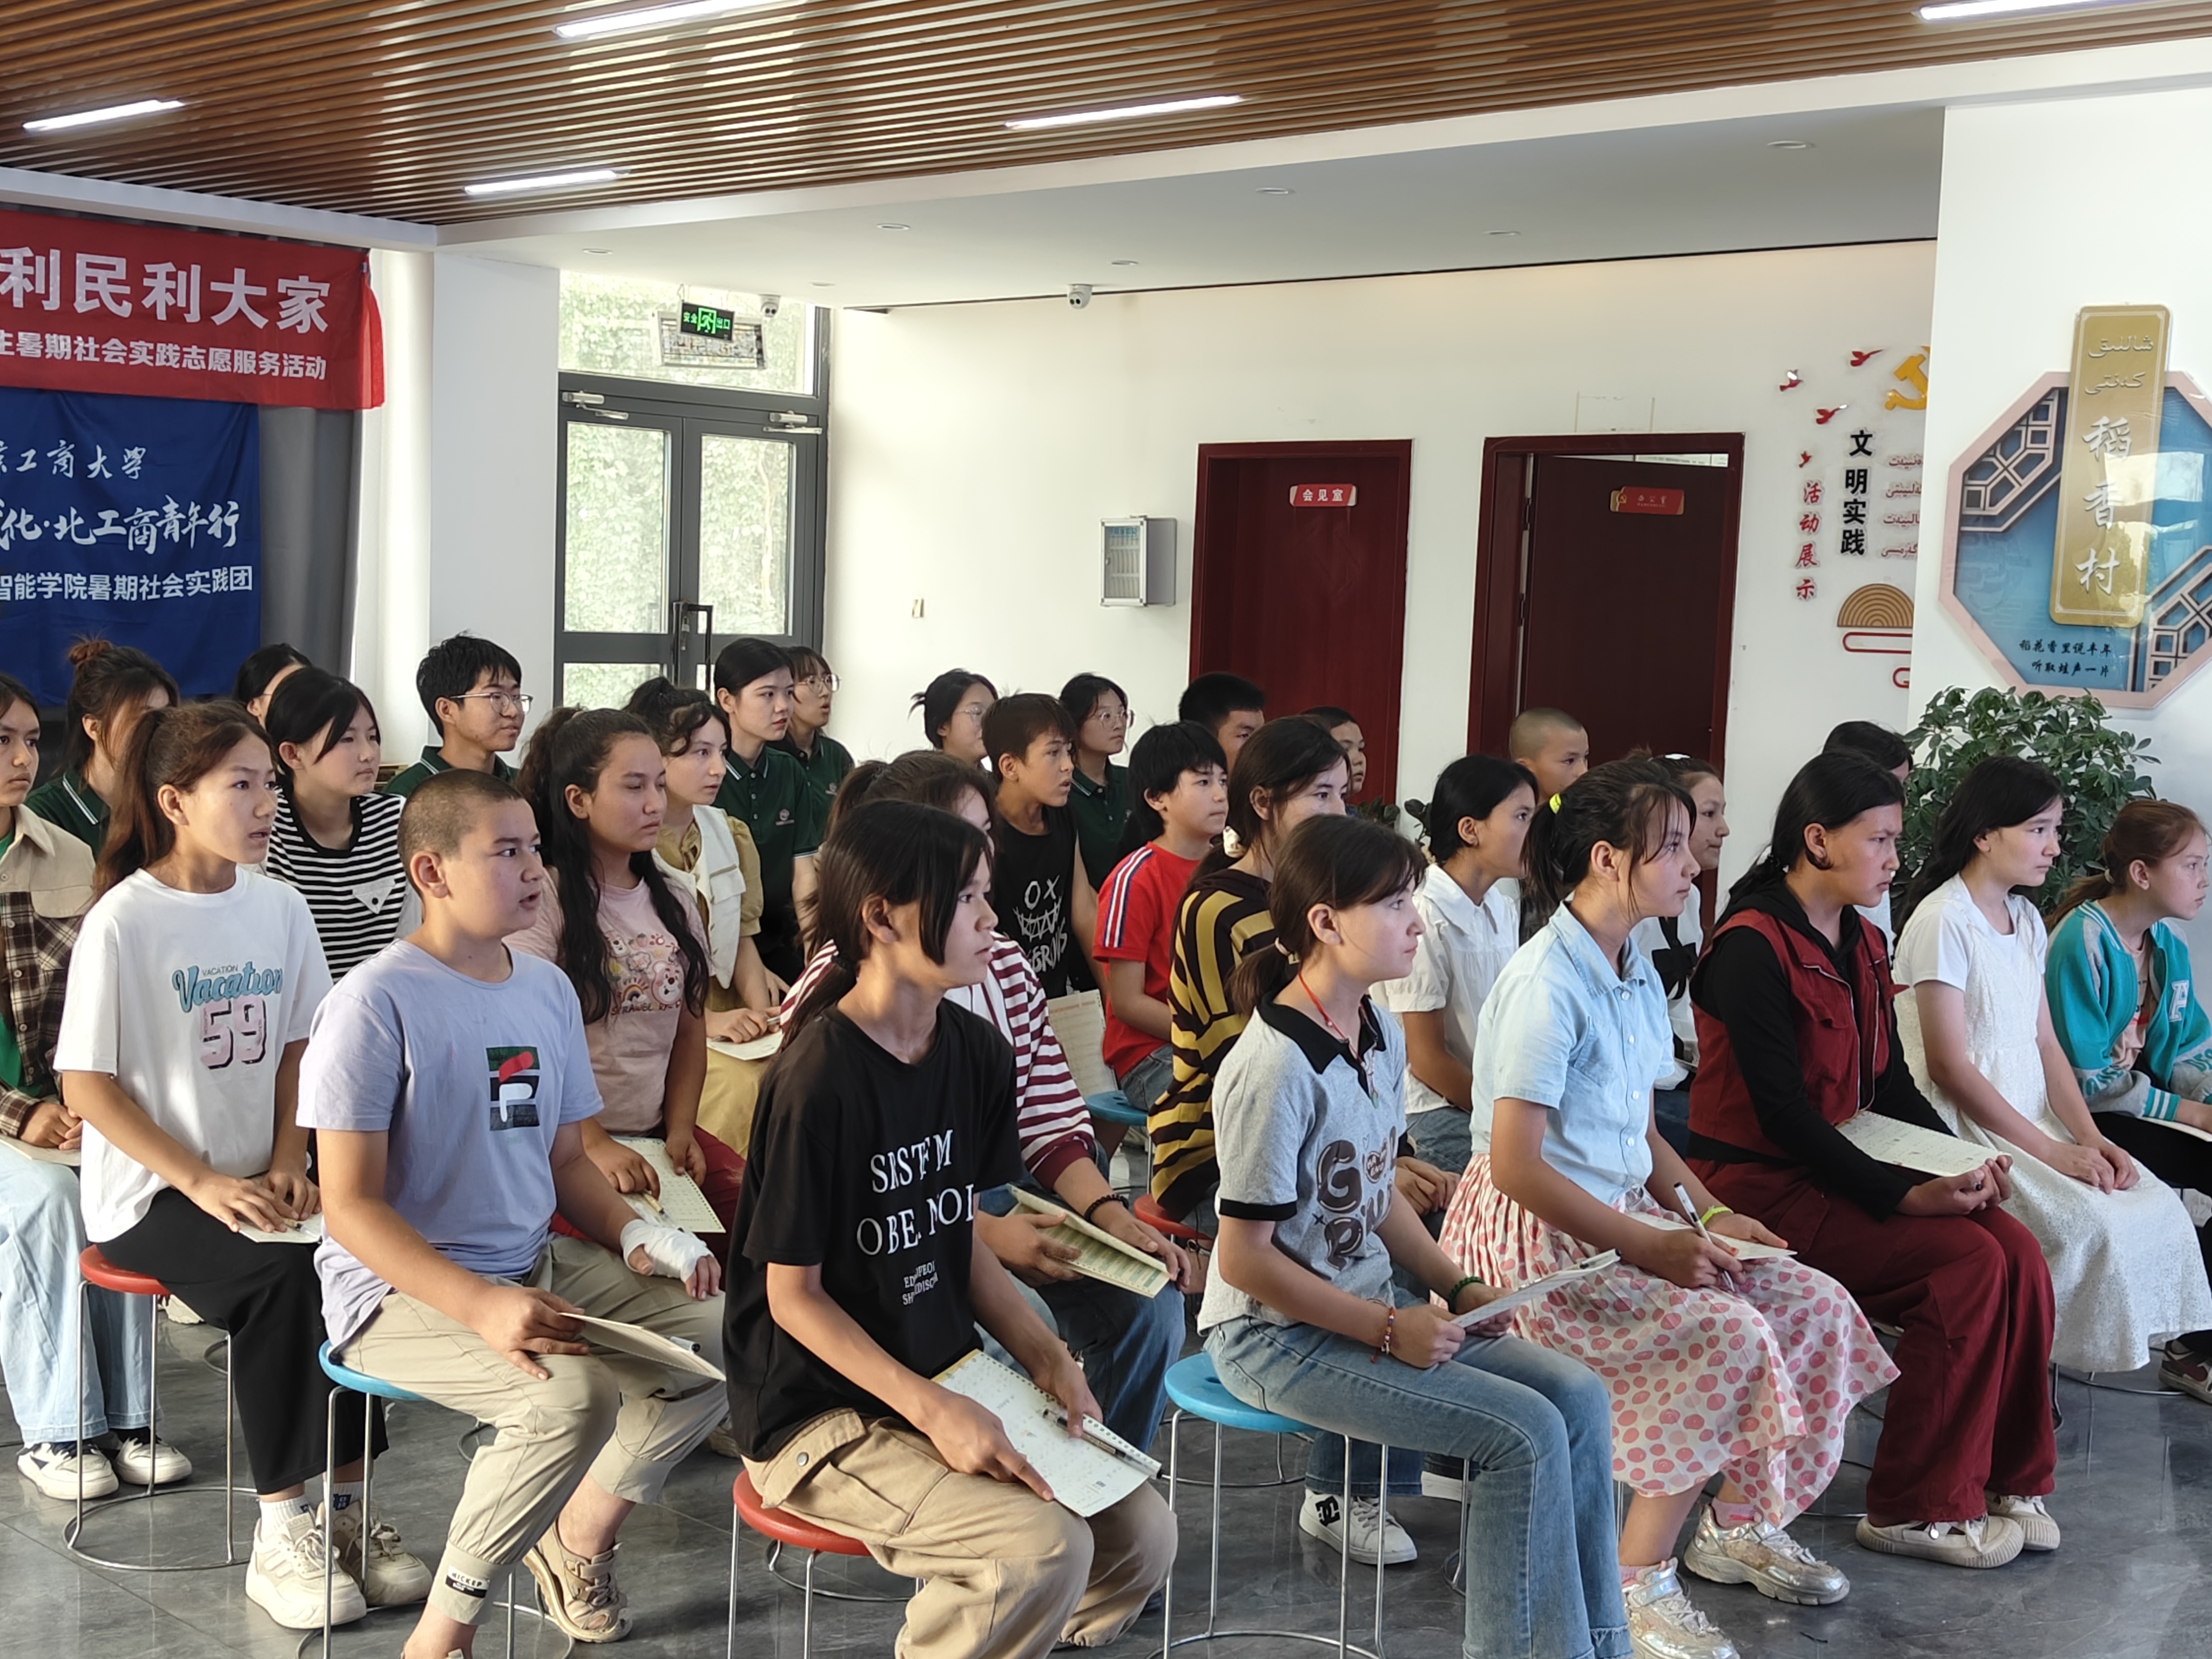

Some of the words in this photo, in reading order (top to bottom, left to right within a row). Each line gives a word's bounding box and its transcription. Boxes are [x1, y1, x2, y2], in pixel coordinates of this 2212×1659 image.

[0, 246, 331, 333] 利民利大家
[1302, 488, 1344, 502] 会见室
[1840, 429, 1873, 556] 文明实践
[2075, 415, 2132, 595] 稻香村
[1795, 482, 1822, 600] 活动展示
[172, 961, 283, 1013] Vacation
[202, 965, 239, 976] VACATION
[199, 996, 267, 1070] 59
